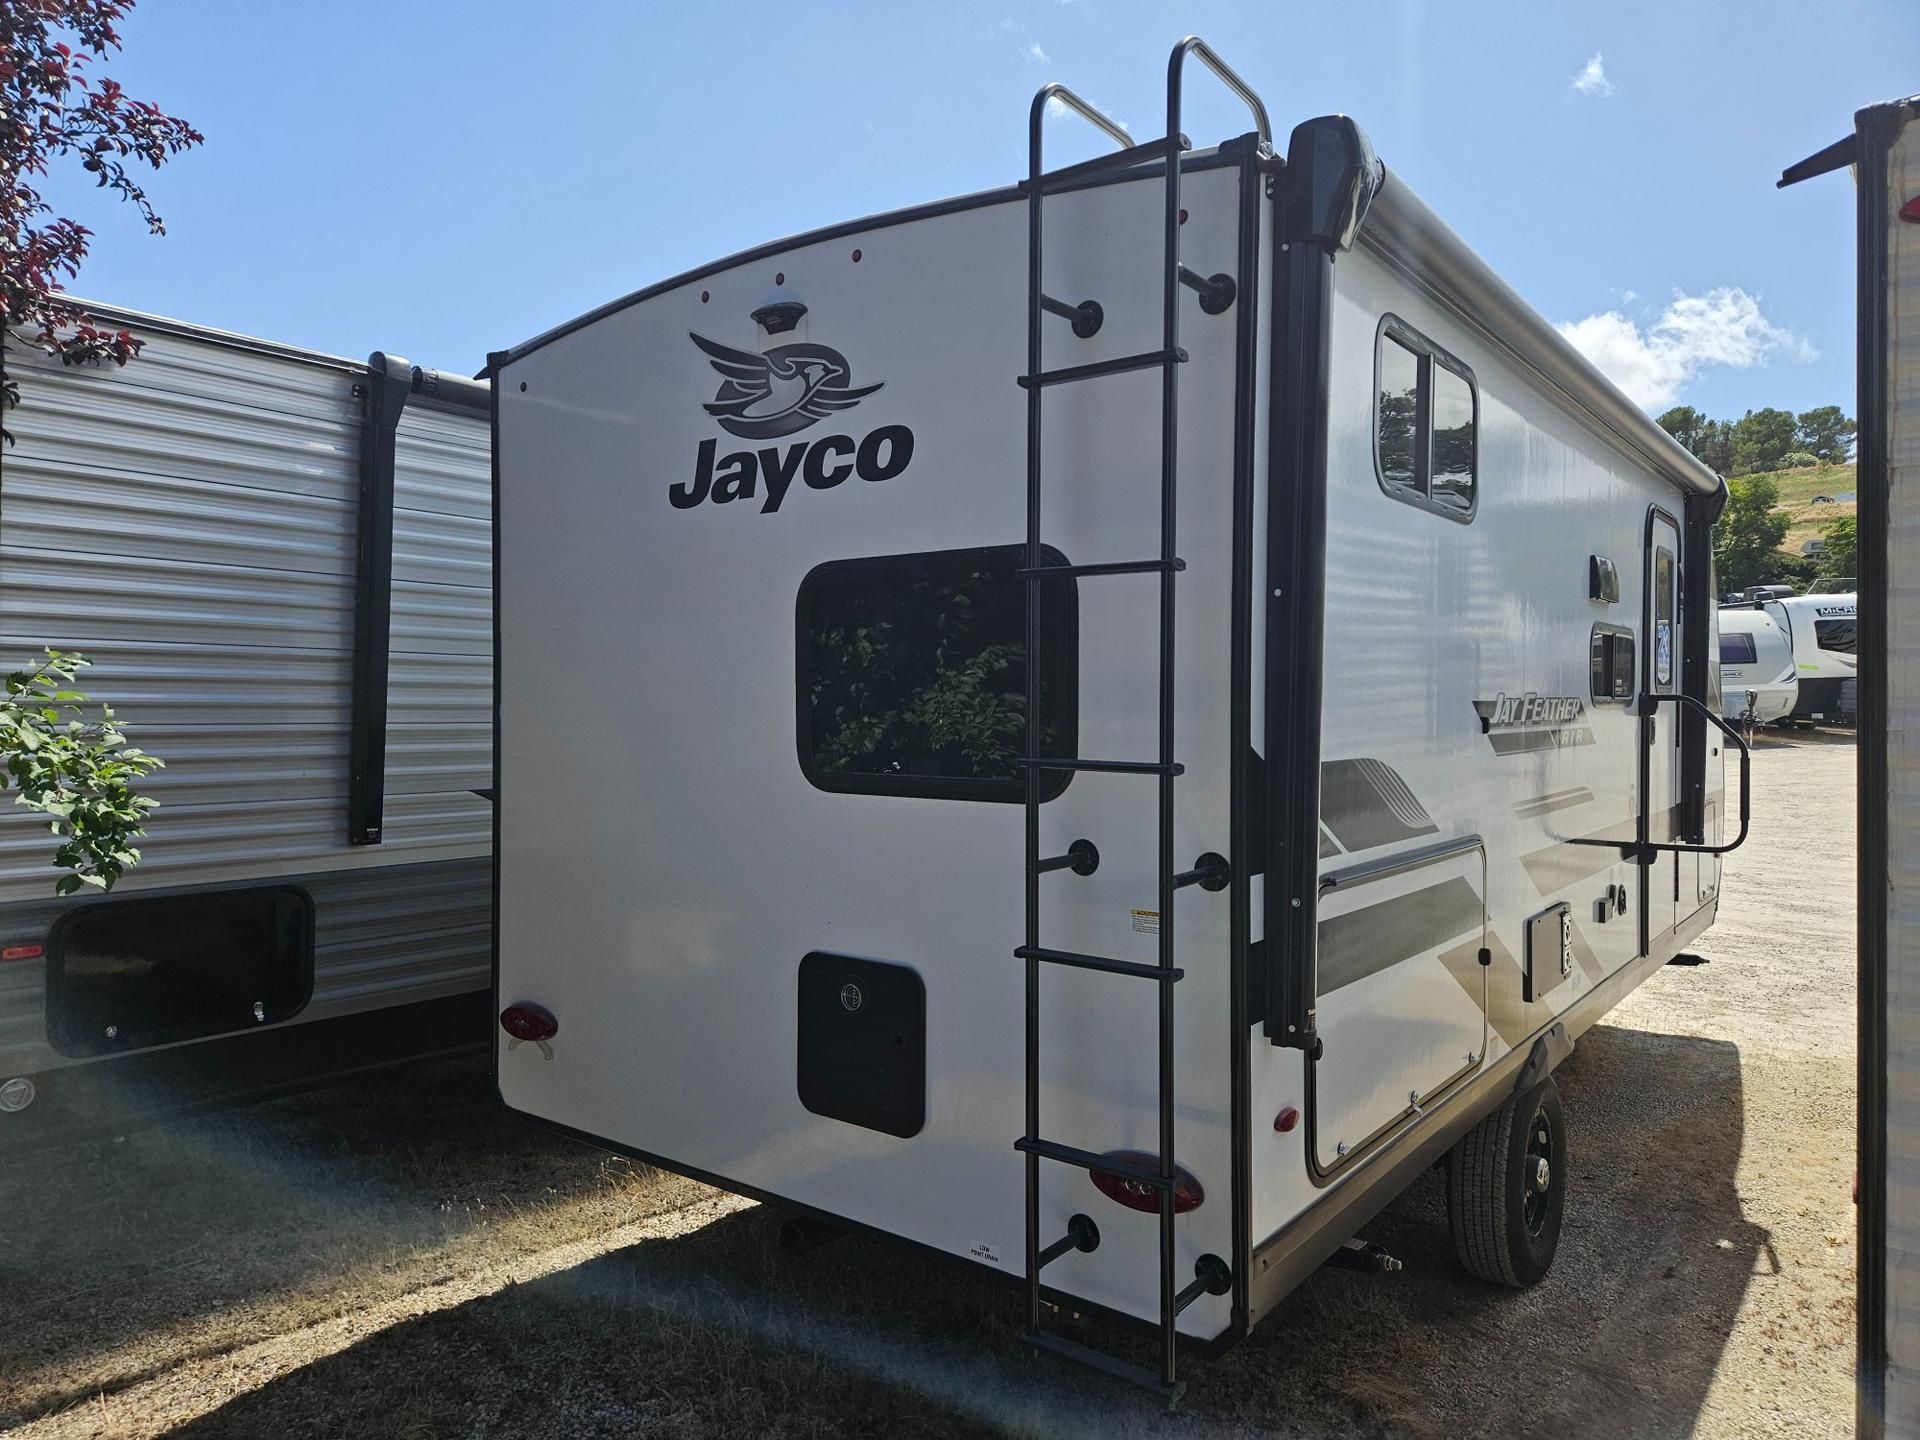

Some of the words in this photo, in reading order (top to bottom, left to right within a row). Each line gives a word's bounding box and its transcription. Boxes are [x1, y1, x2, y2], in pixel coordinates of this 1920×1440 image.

[668, 424, 915, 515] Jayco
[1489, 692, 1521, 724] JAY
[1520, 692, 1581, 722] FEATHER
